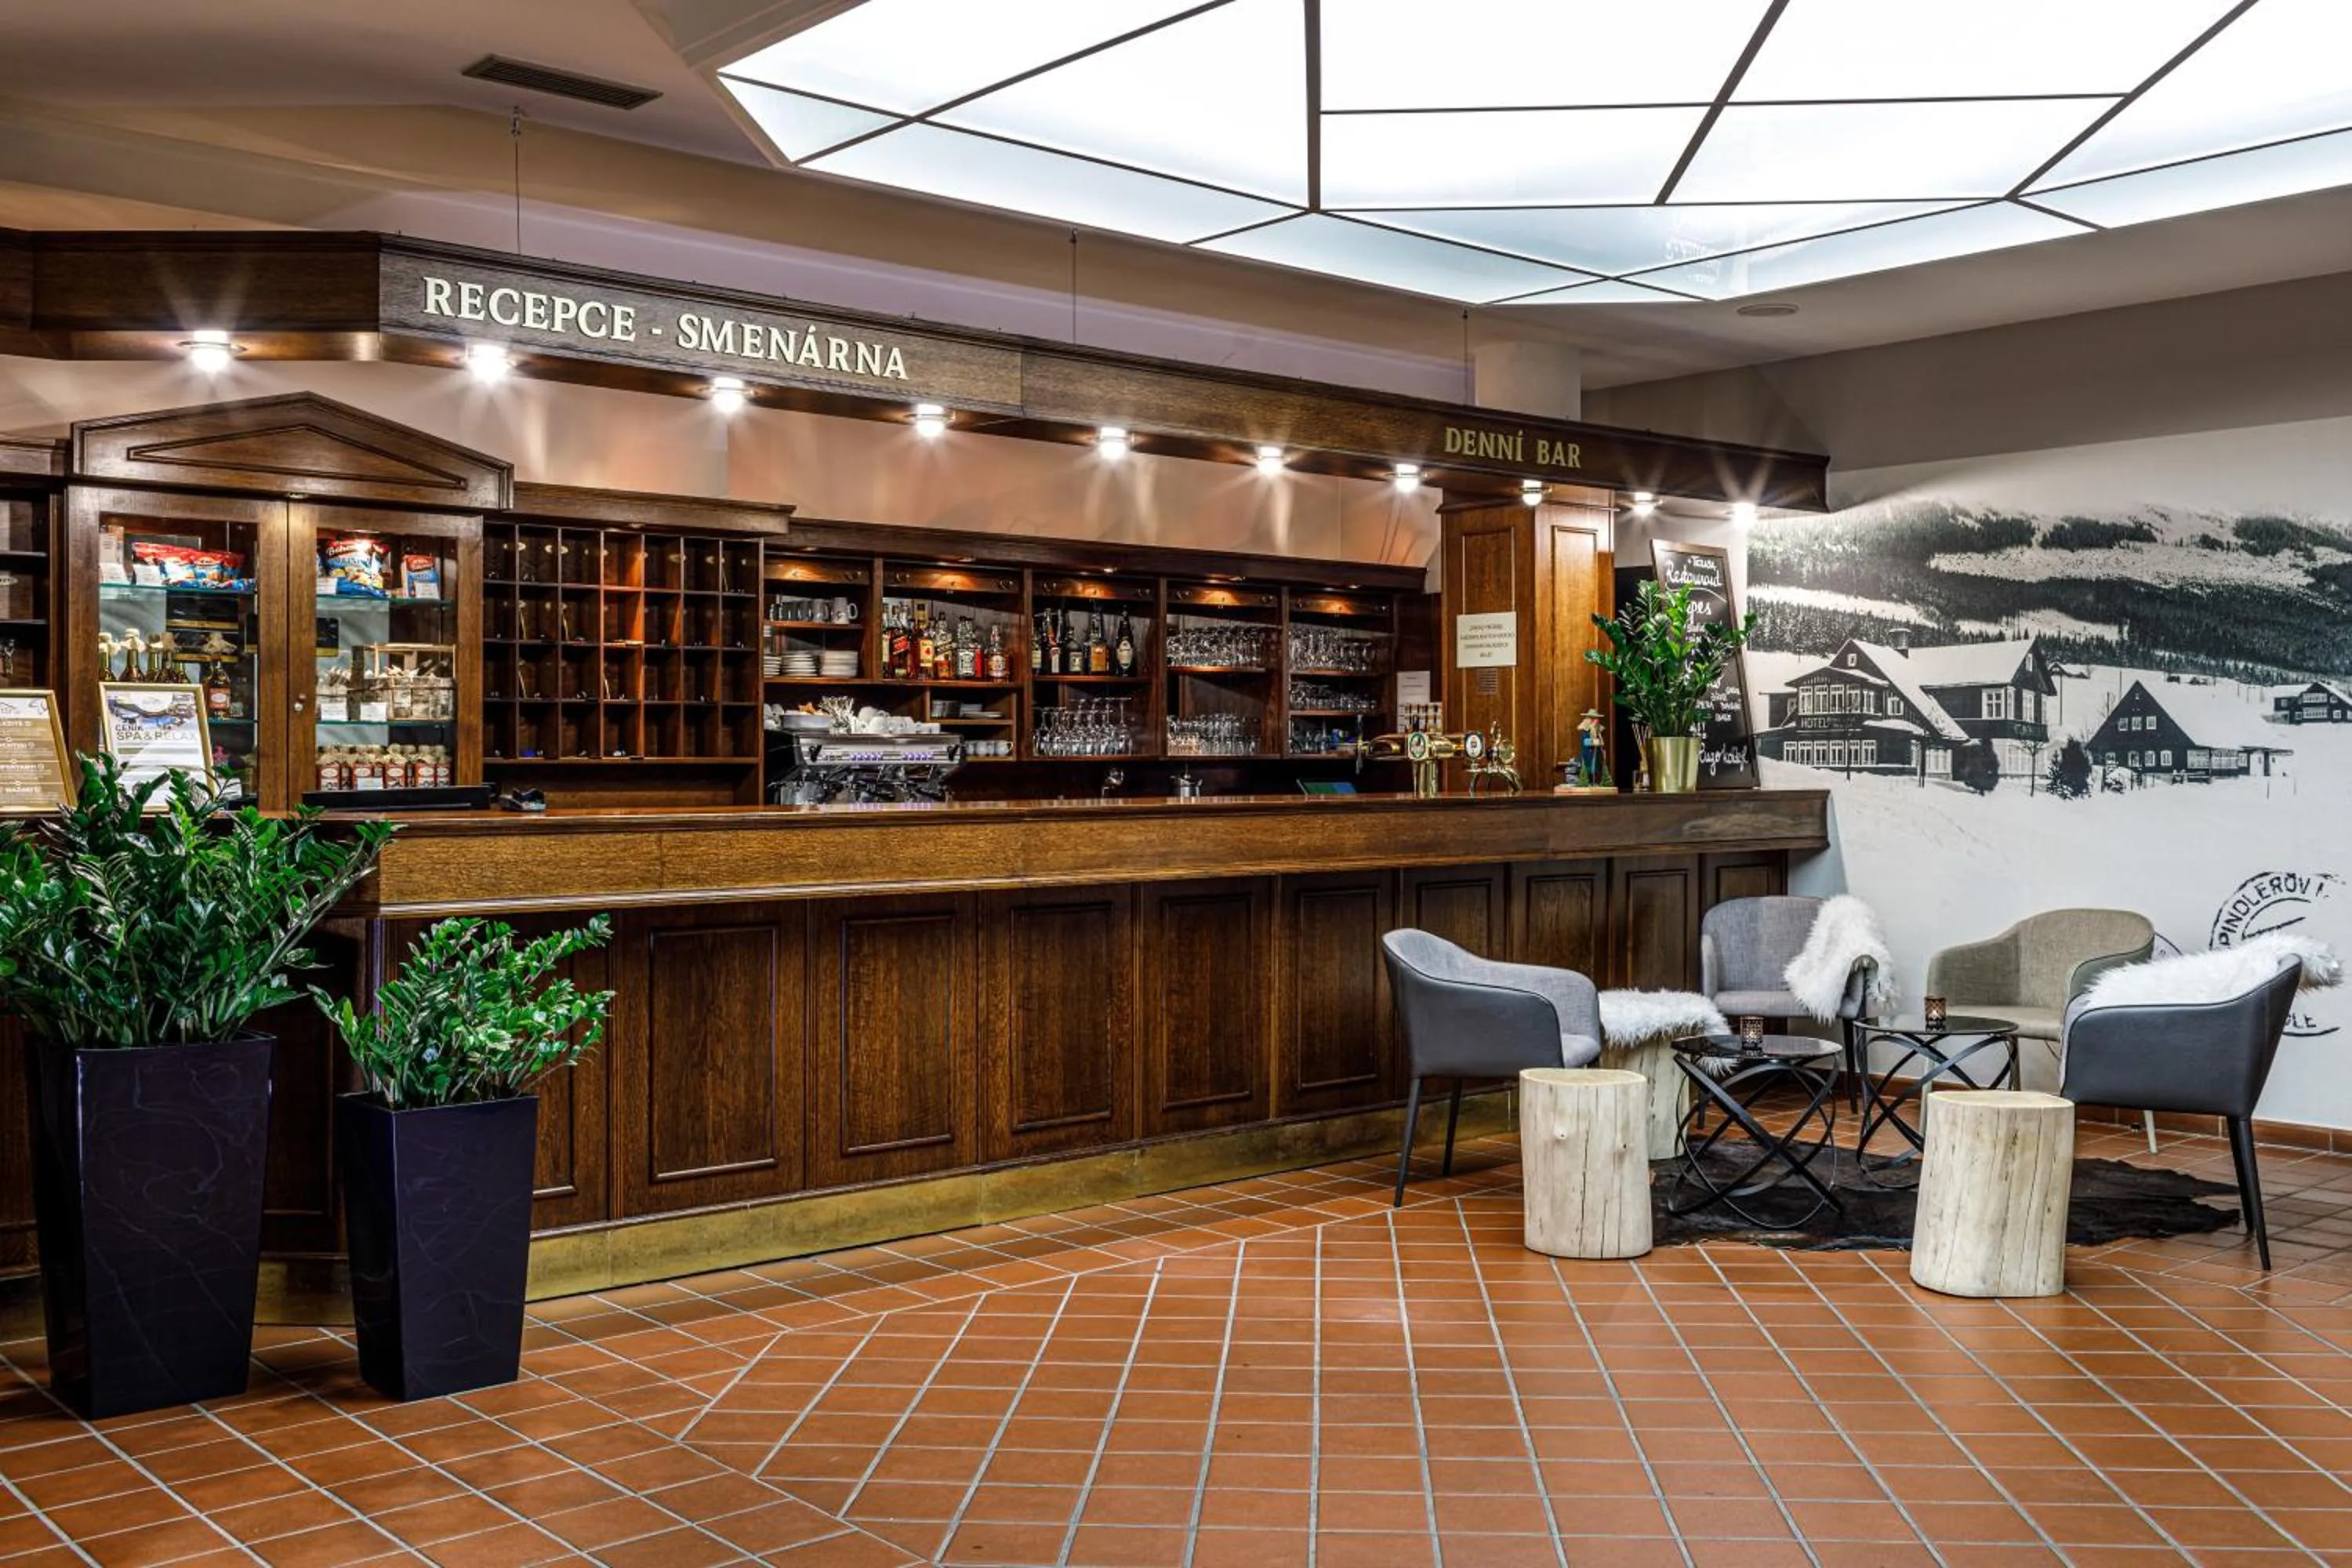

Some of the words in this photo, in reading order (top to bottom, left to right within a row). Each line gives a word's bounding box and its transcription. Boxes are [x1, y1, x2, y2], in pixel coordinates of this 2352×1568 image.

[423, 276, 636, 342] RECEPCE
[678, 313, 910, 380] SMENÁRNA
[1444, 426, 1524, 462] DENNÍ
[1537, 439, 1581, 468] BAR
[1801, 717, 1828, 728] HOTEL
[117, 731, 142, 741] SPA
